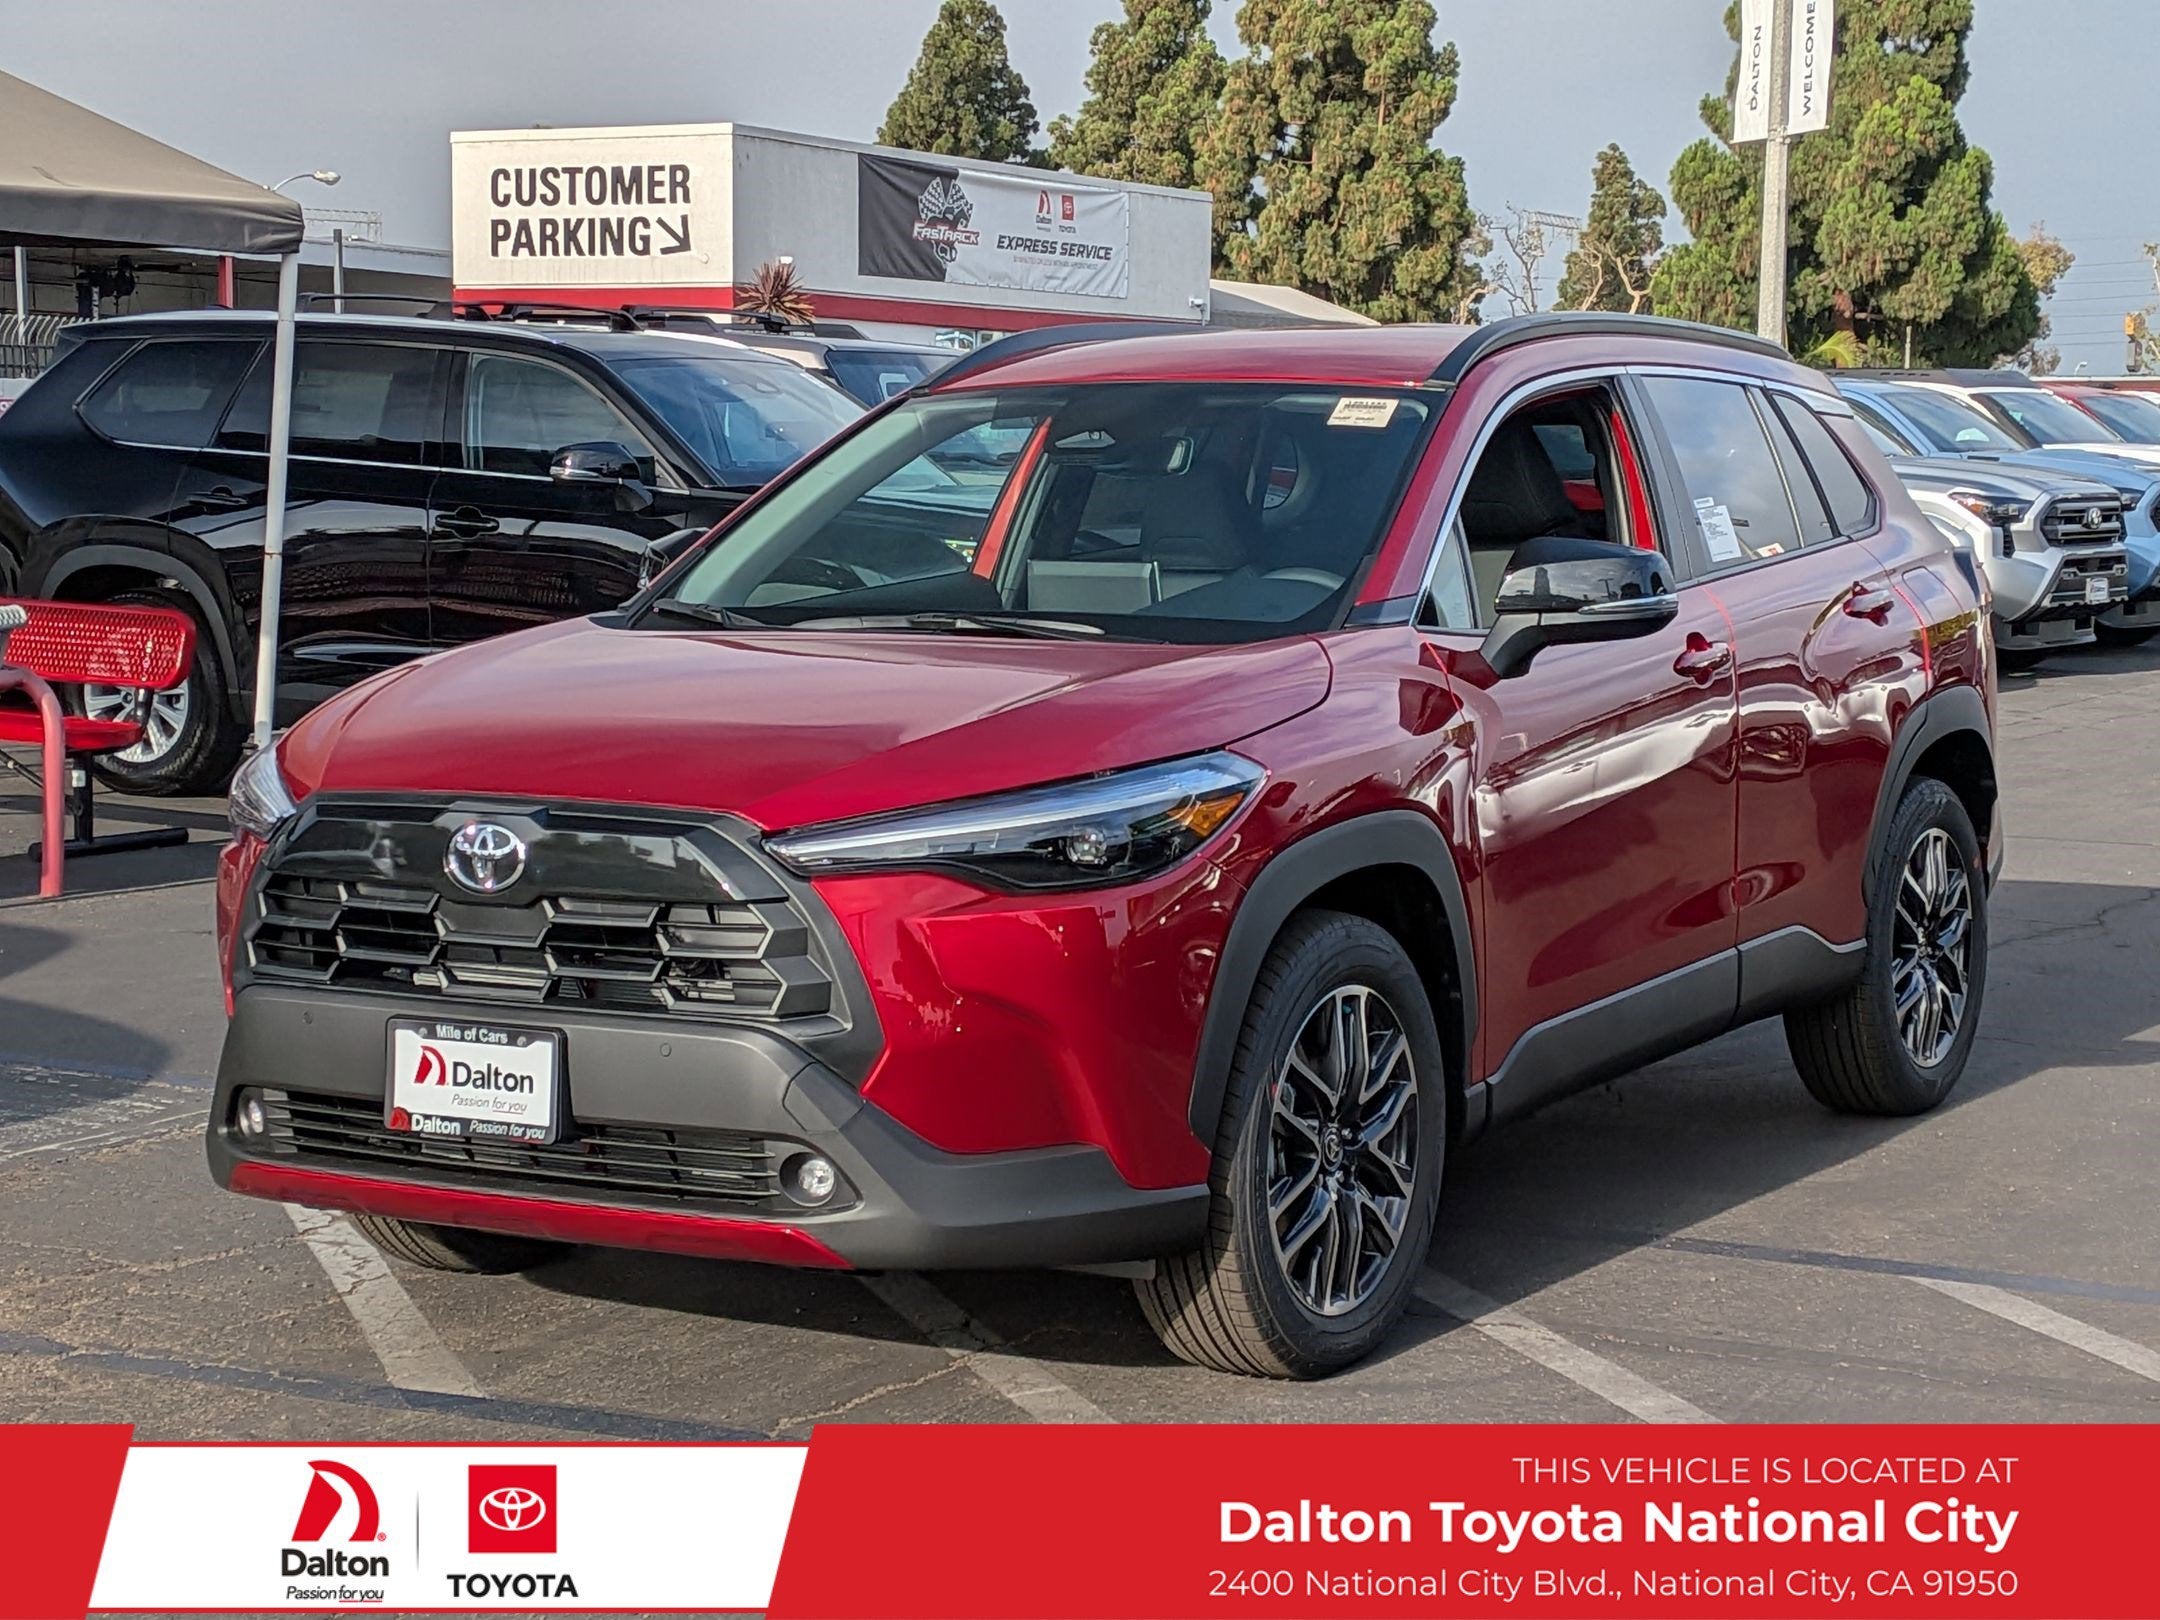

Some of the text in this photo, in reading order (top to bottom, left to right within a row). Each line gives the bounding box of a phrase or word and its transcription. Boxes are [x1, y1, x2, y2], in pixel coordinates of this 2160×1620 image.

[1750, 25, 1762, 111] DALTON
[1803, 2, 1815, 116] WELCOME
[491, 164, 691, 207] CUSTOMER
[491, 216, 651, 257] PARKING
[996, 234, 1113, 260] EXPRESS SERVICE
[436, 1024, 508, 1044] Mile of Cars
[452, 1061, 534, 1094] Dalton
[451, 1094, 528, 1112] Passion for you
[411, 1114, 546, 1140] Dalton Passion for you
